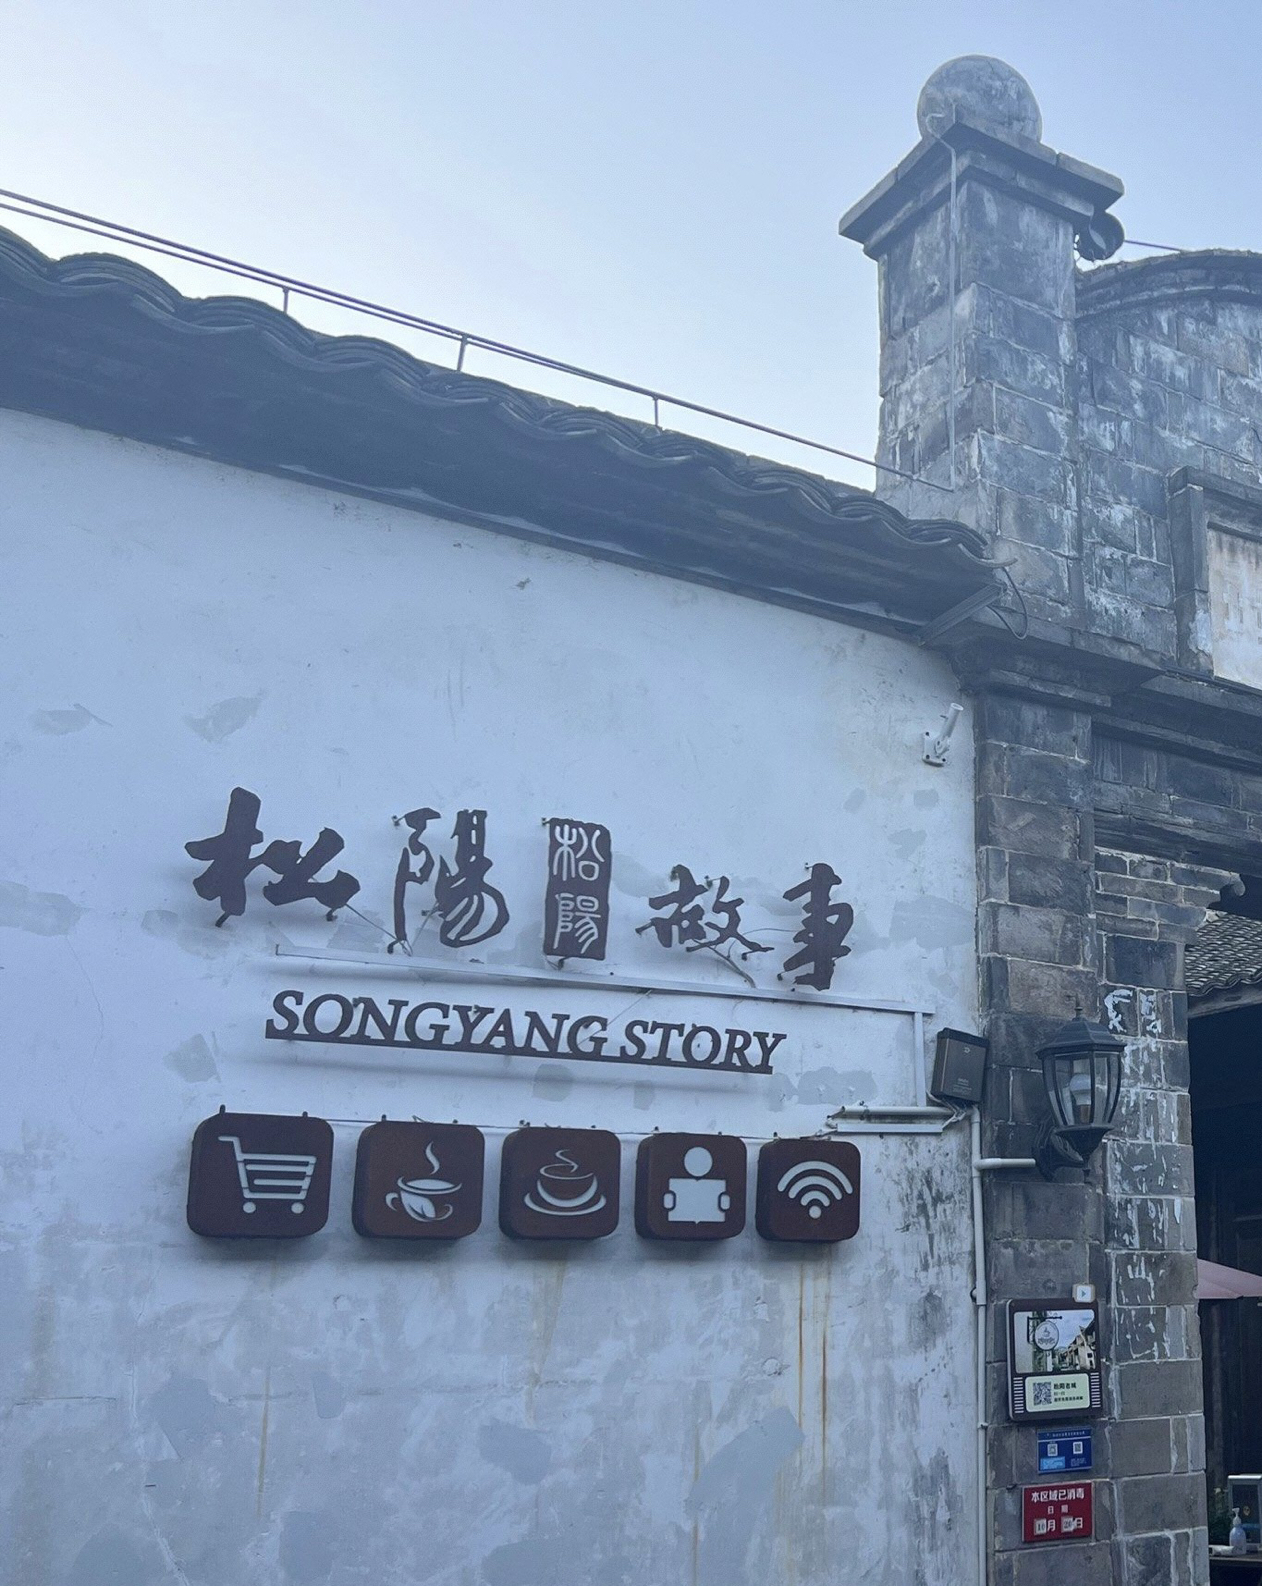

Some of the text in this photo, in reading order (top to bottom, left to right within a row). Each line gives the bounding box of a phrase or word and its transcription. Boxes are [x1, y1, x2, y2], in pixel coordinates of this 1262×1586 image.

[266, 989, 787, 1074] SONGYANG STORY
[1031, 1488, 1085, 1503] 本区域已消毒
